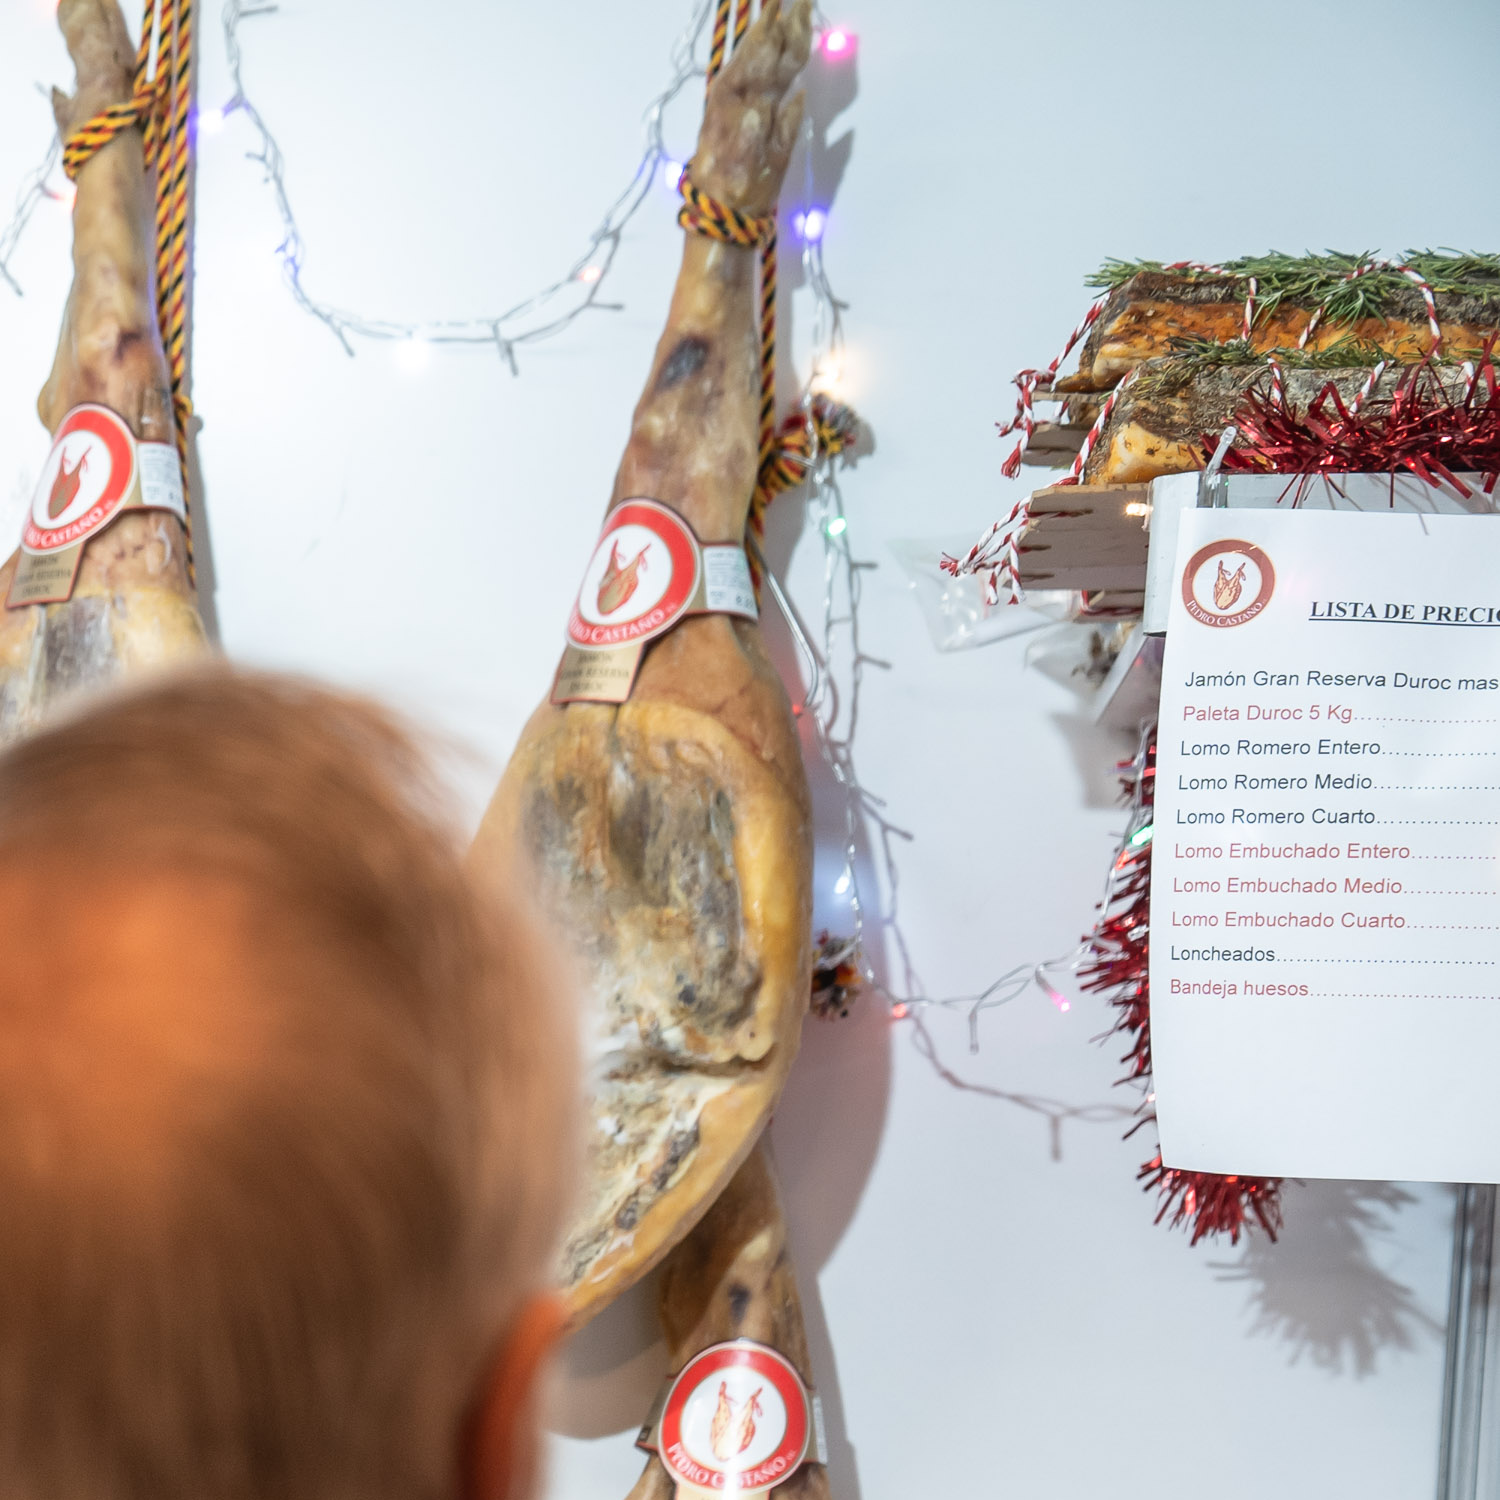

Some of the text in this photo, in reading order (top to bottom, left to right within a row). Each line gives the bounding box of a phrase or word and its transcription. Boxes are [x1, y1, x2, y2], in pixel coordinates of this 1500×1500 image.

[1187, 600, 1216, 625] PEDRO
[1311, 602, 1376, 618] LISTA
[1383, 604, 1414, 619] DE
[1185, 671, 1498, 690] Jamón Gran Reserva Duroc mas
[1184, 705, 1352, 724] Paleta Duroc 5 Kg
[1181, 739, 1380, 755] Lomo Romero Entero
[1179, 774, 1372, 790] Lomo Romero Medio
[1177, 809, 1375, 824] Lomo Romero Cuarto
[1176, 843, 1409, 858] Lomo Embuchado Entero
[1174, 878, 1402, 893] Lomo Embuchado Medio
[1173, 912, 1405, 928] Lomo Embuchado Cuarto
[1172, 946, 1275, 961] Loncheados
[1171, 979, 1308, 999] Bandeja huesos
